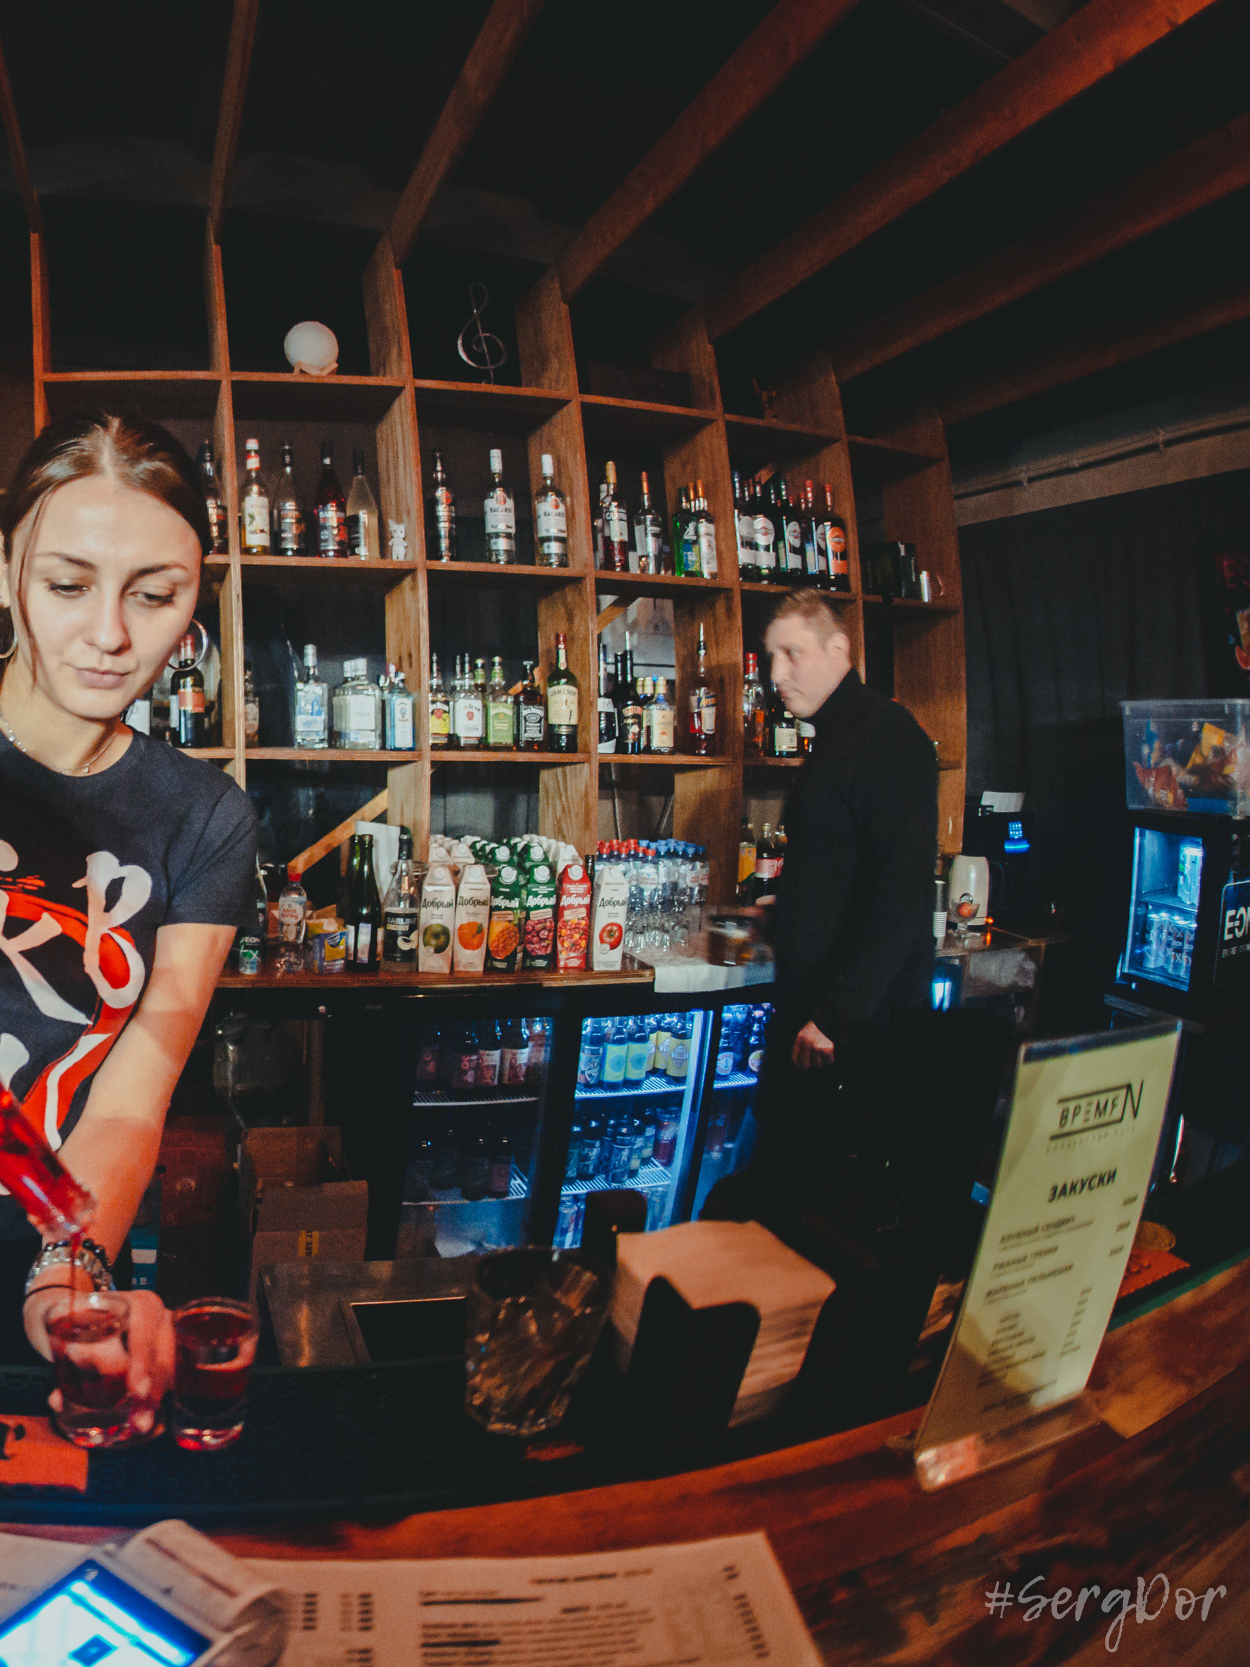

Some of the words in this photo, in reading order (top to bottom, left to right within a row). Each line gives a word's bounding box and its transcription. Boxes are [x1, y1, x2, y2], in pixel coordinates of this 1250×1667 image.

[422, 897, 453, 910] Добрый
[526, 894, 556, 907] Добрый
[560, 894, 590, 907] Добрый
[1048, 1168, 1117, 1204] ЗАКУСКИ
